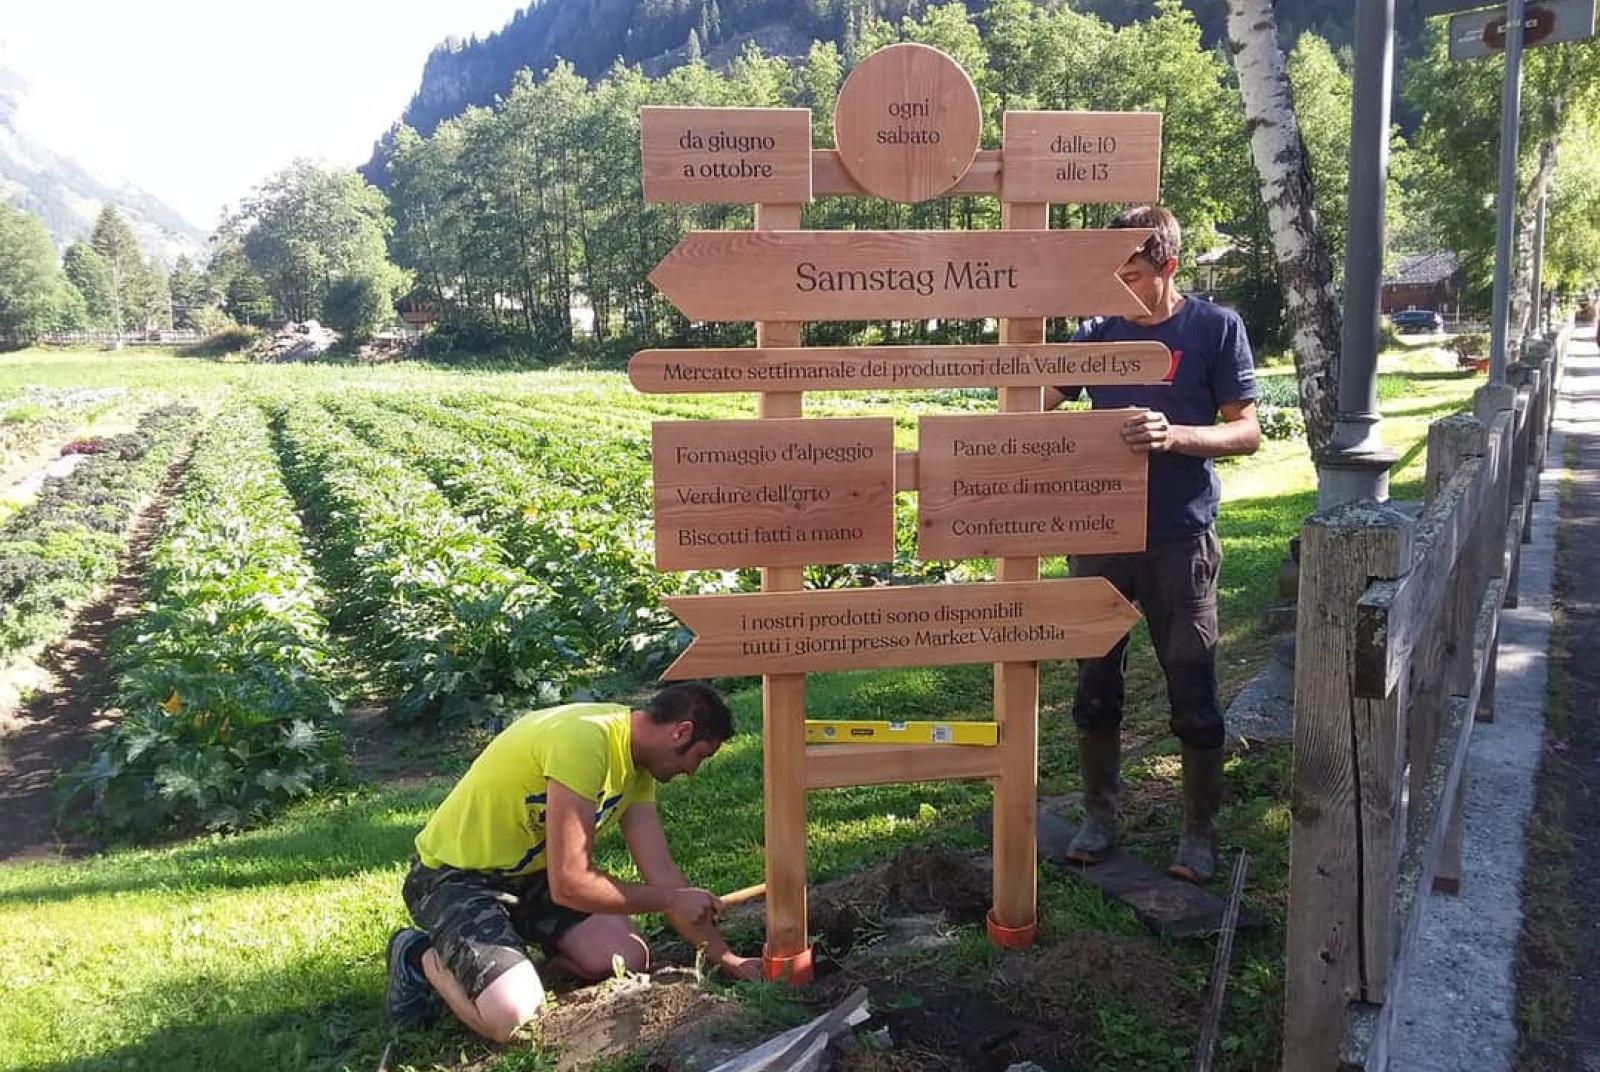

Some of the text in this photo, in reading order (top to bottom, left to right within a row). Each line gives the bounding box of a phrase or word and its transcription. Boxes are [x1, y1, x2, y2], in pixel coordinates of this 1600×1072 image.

[888, 98, 930, 119] ogni
[679, 129, 775, 152] da giugno
[876, 126, 940, 145] sabato
[1050, 136, 1116, 154] dalle 10
[683, 159, 773, 178] a ottobre
[1056, 163, 1109, 181] alle 13
[796, 261, 1018, 295] Samstag Märt
[663, 355, 1141, 382] Mercato settimanale dei produttori della Valle del Lys
[676, 445, 776, 465] Formaggio
[953, 436, 1076, 456] Pane di segale
[677, 486, 751, 504] Verdure
[953, 478, 1122, 496] Patate di montagna
[952, 514, 1115, 536] Confetture & miele
[678, 526, 863, 546] Biscotti fatti a mano
[752, 612, 804, 630] nostri
[809, 609, 881, 631] prodotti
[886, 609, 930, 624] sono
[934, 601, 1023, 624] disponibili
[742, 638, 780, 655] tutti
[795, 635, 846, 655] giorni
[851, 635, 910, 653] presso
[915, 630, 978, 646] Market
[980, 625, 1065, 643] Valdobbia
